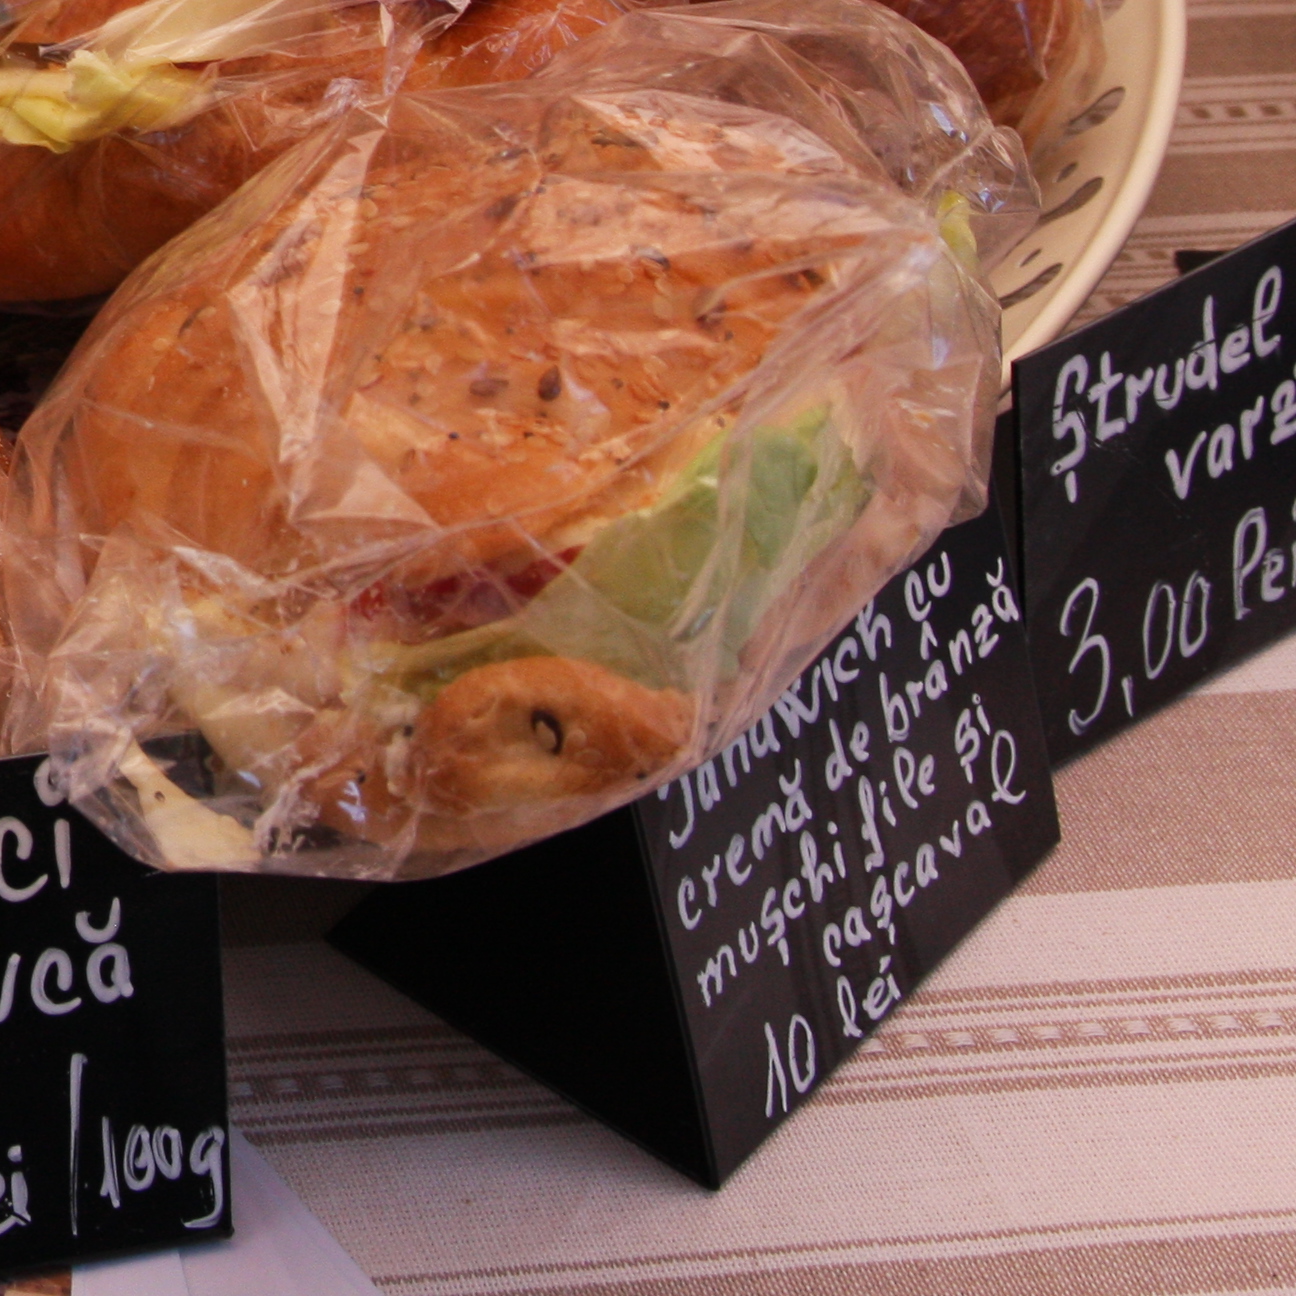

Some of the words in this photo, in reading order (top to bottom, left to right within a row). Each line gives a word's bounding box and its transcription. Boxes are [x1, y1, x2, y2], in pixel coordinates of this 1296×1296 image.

[904, 551, 951, 622] cu
[1059, 576, 1211, 736] 3,00
[677, 758, 813, 930] cremă
[825, 718, 870, 791] de
[879, 556, 1019, 743] brânză
[696, 820, 846, 1007] mușchi
[858, 748, 936, 873] file
[822, 730, 1027, 968] cașcaval
[764, 1014, 815, 1119] 10
[837, 956, 902, 1038] lei
